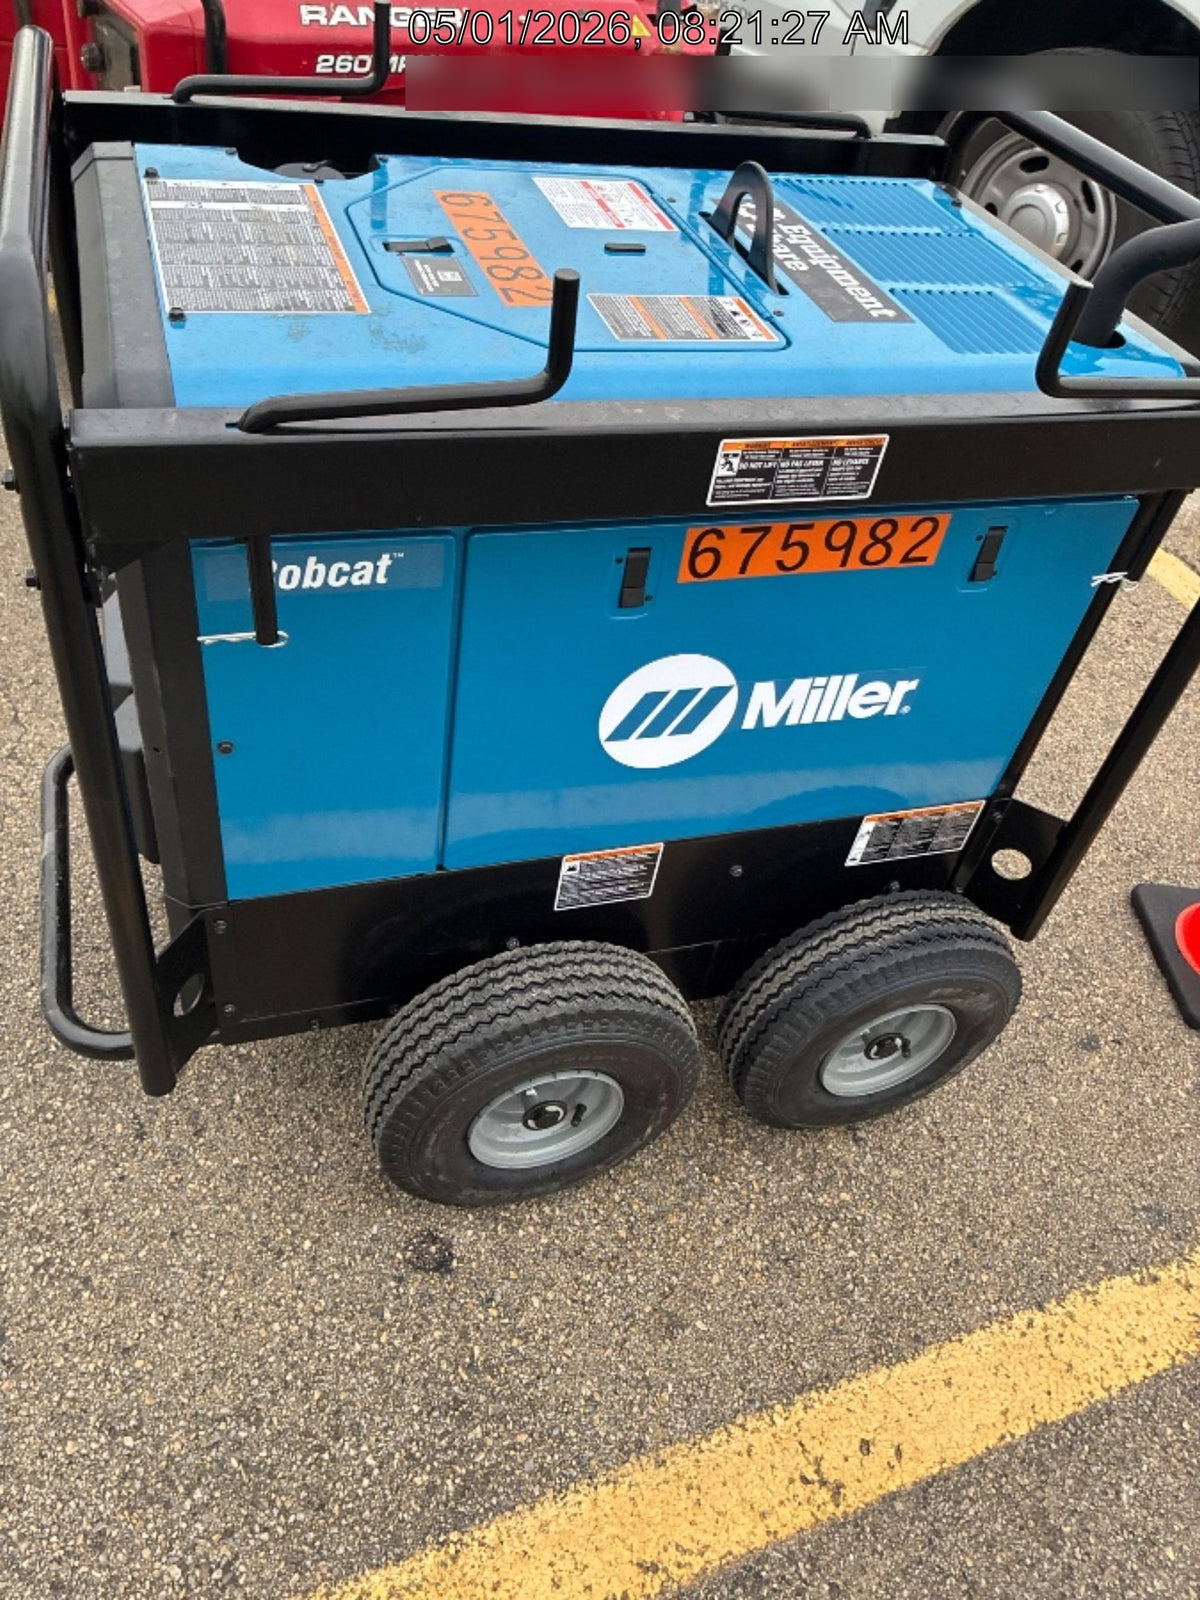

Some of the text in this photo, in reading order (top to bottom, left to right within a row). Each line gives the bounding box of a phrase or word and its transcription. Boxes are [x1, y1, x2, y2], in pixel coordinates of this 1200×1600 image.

[299, 4, 463, 28] RANGER
[778, 223, 898, 318] Equipment
[687, 516, 940, 580] 675982
